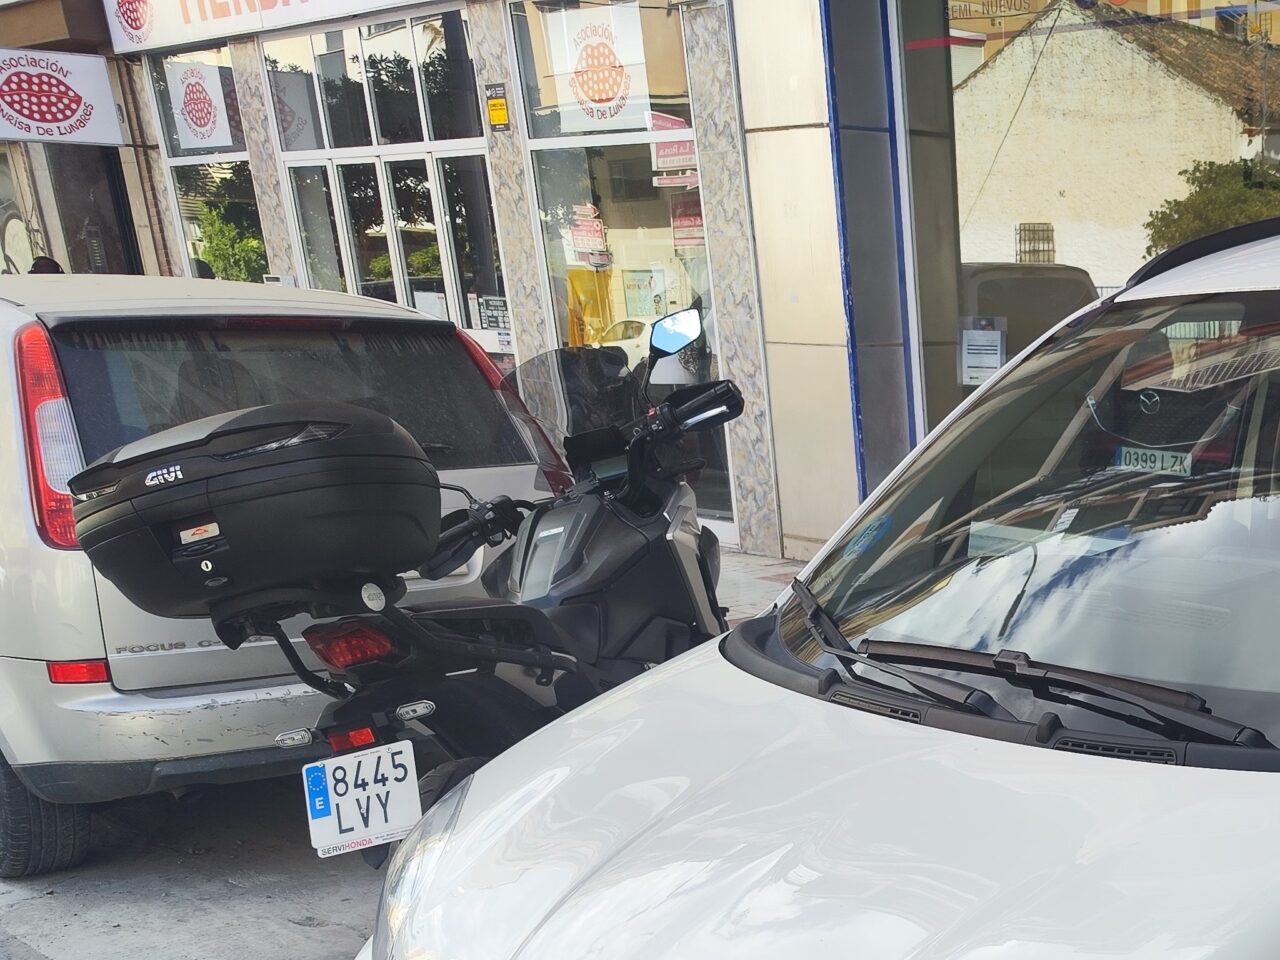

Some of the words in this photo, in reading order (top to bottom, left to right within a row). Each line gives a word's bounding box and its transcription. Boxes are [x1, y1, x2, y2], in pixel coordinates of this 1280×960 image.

[1124, 450, 1157, 470] 0399
[1161, 454, 1188, 474] LZK
[145, 465, 184, 487] GIVI
[116, 641, 186, 655] FOCUS
[332, 750, 408, 797] 8445
[315, 796, 325, 810] E
[336, 790, 390, 834] LVY
[321, 837, 373, 856] SERVIHONDA
